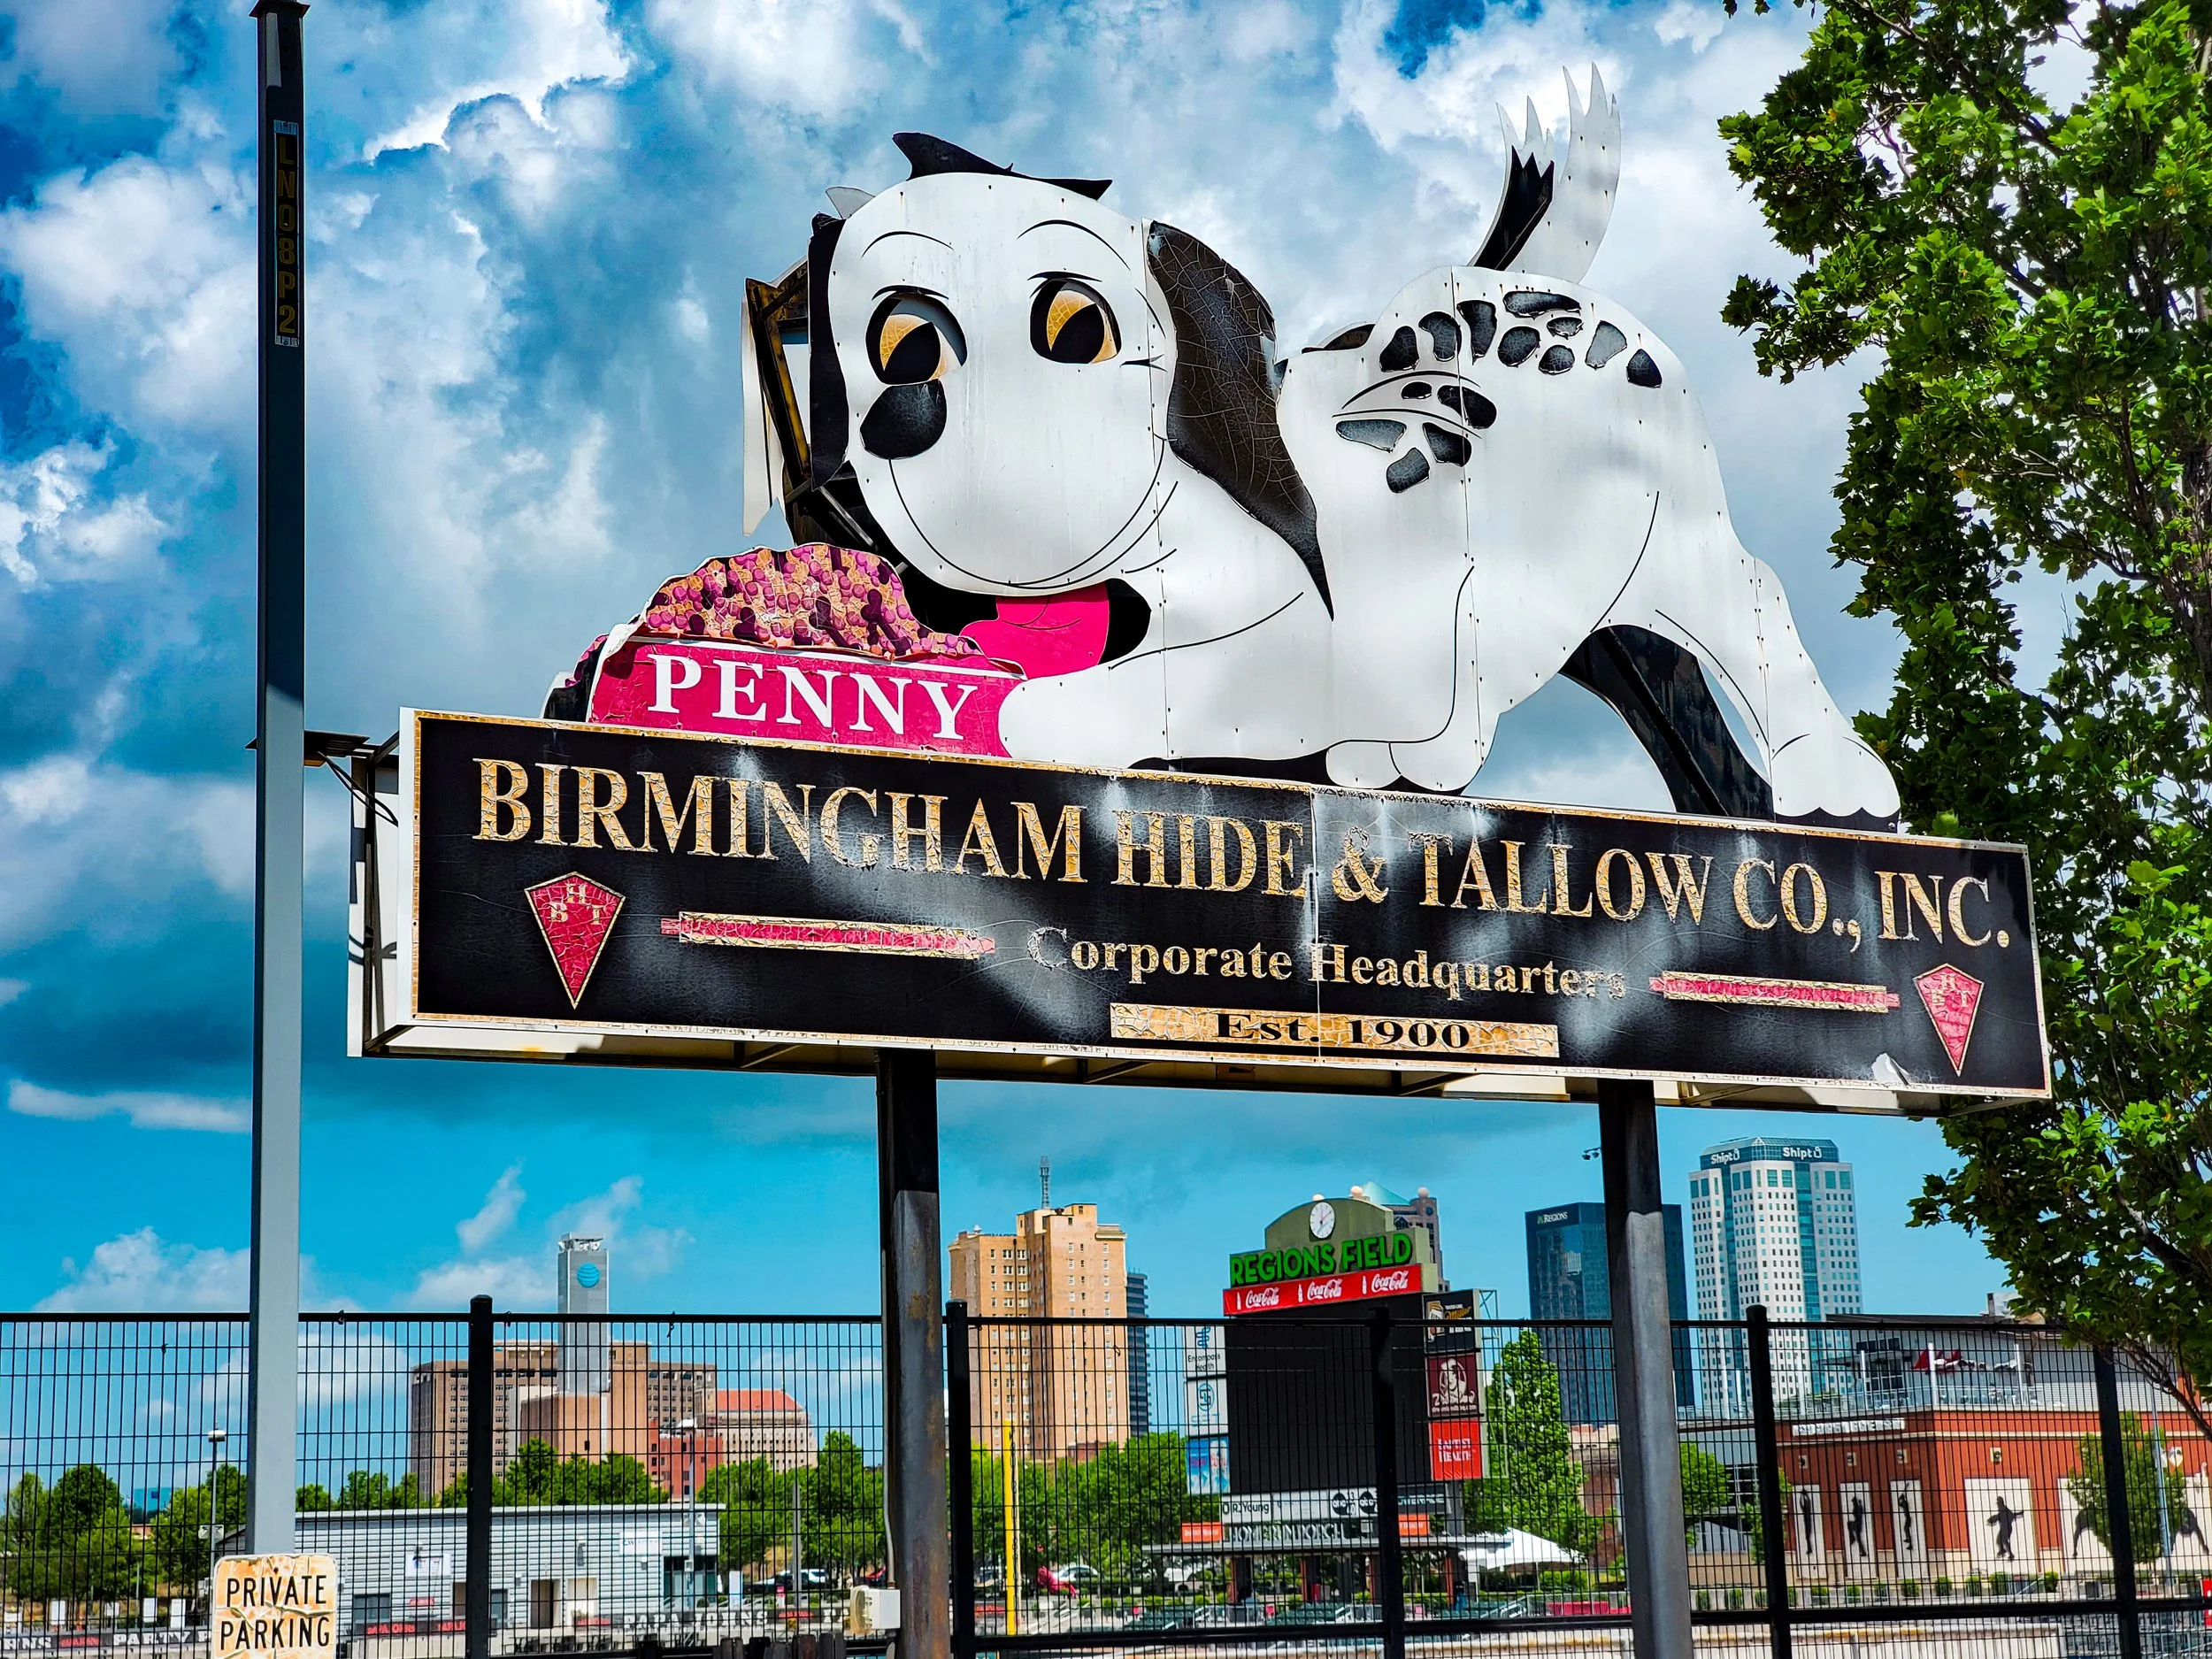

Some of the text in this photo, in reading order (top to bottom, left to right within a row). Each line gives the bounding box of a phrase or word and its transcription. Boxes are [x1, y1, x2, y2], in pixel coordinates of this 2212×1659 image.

[647, 653, 979, 741] PENNY
[472, 757, 2010, 953] BIRMINGHAM HIDE & TALLOW CO., INC.
[1027, 926, 1626, 1002] Corporate Headquarters
[1215, 1012, 1471, 1049] Est. 1900
[1710, 1152, 1732, 1165] Shipt
[1783, 1146, 1813, 1161] Shipt
[1542, 1211, 1569, 1224] REGIONS
[1229, 1233, 1413, 1286] REGIONS FIELD
[1187, 1353, 1221, 1363] Enompas
[227, 1575, 326, 1608] PRIVATE
[113, 1631, 191, 1646] PARTY
[220, 1616, 330, 1650] PARKING
